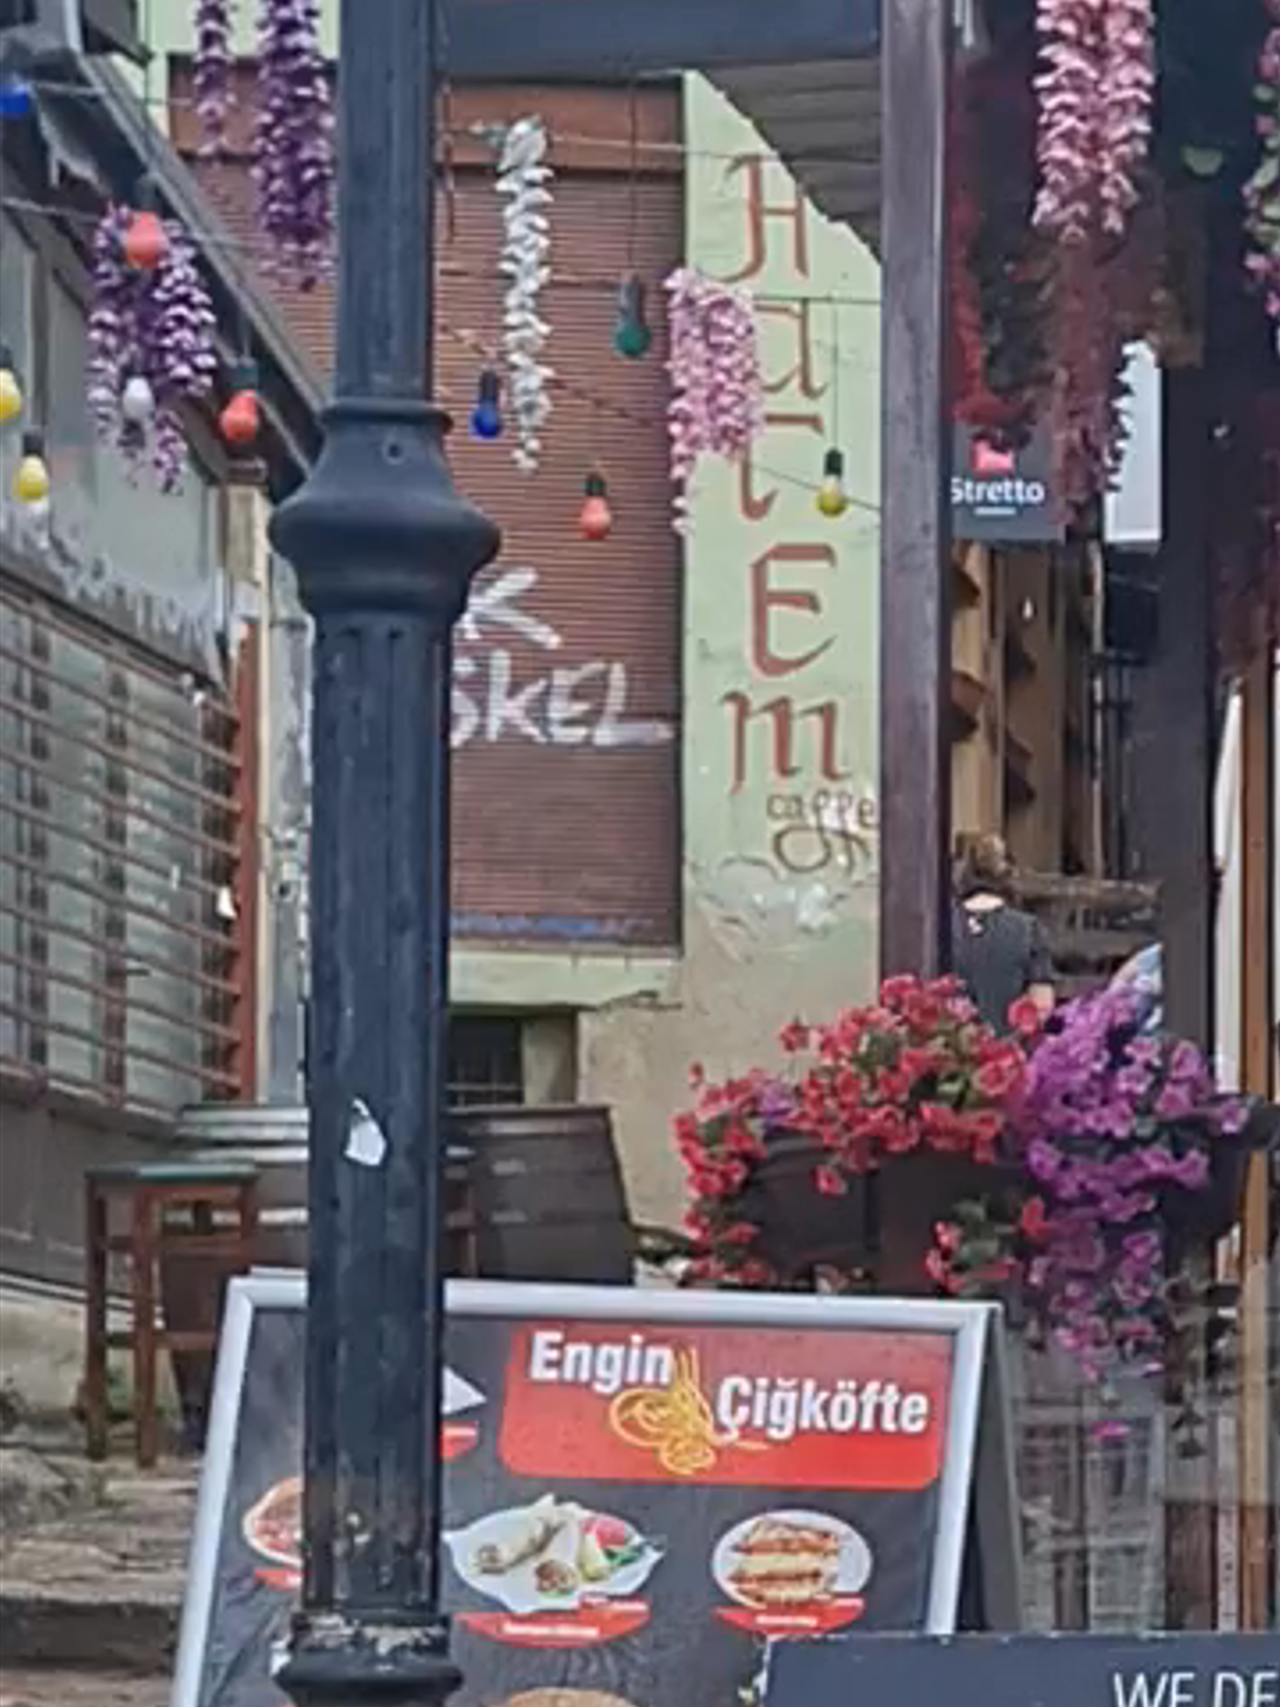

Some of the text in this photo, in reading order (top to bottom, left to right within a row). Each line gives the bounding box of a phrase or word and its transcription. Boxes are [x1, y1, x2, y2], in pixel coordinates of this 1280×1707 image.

[950, 475, 1046, 507] Stretto
[529, 1330, 931, 1443] Engin Çiğköfte
